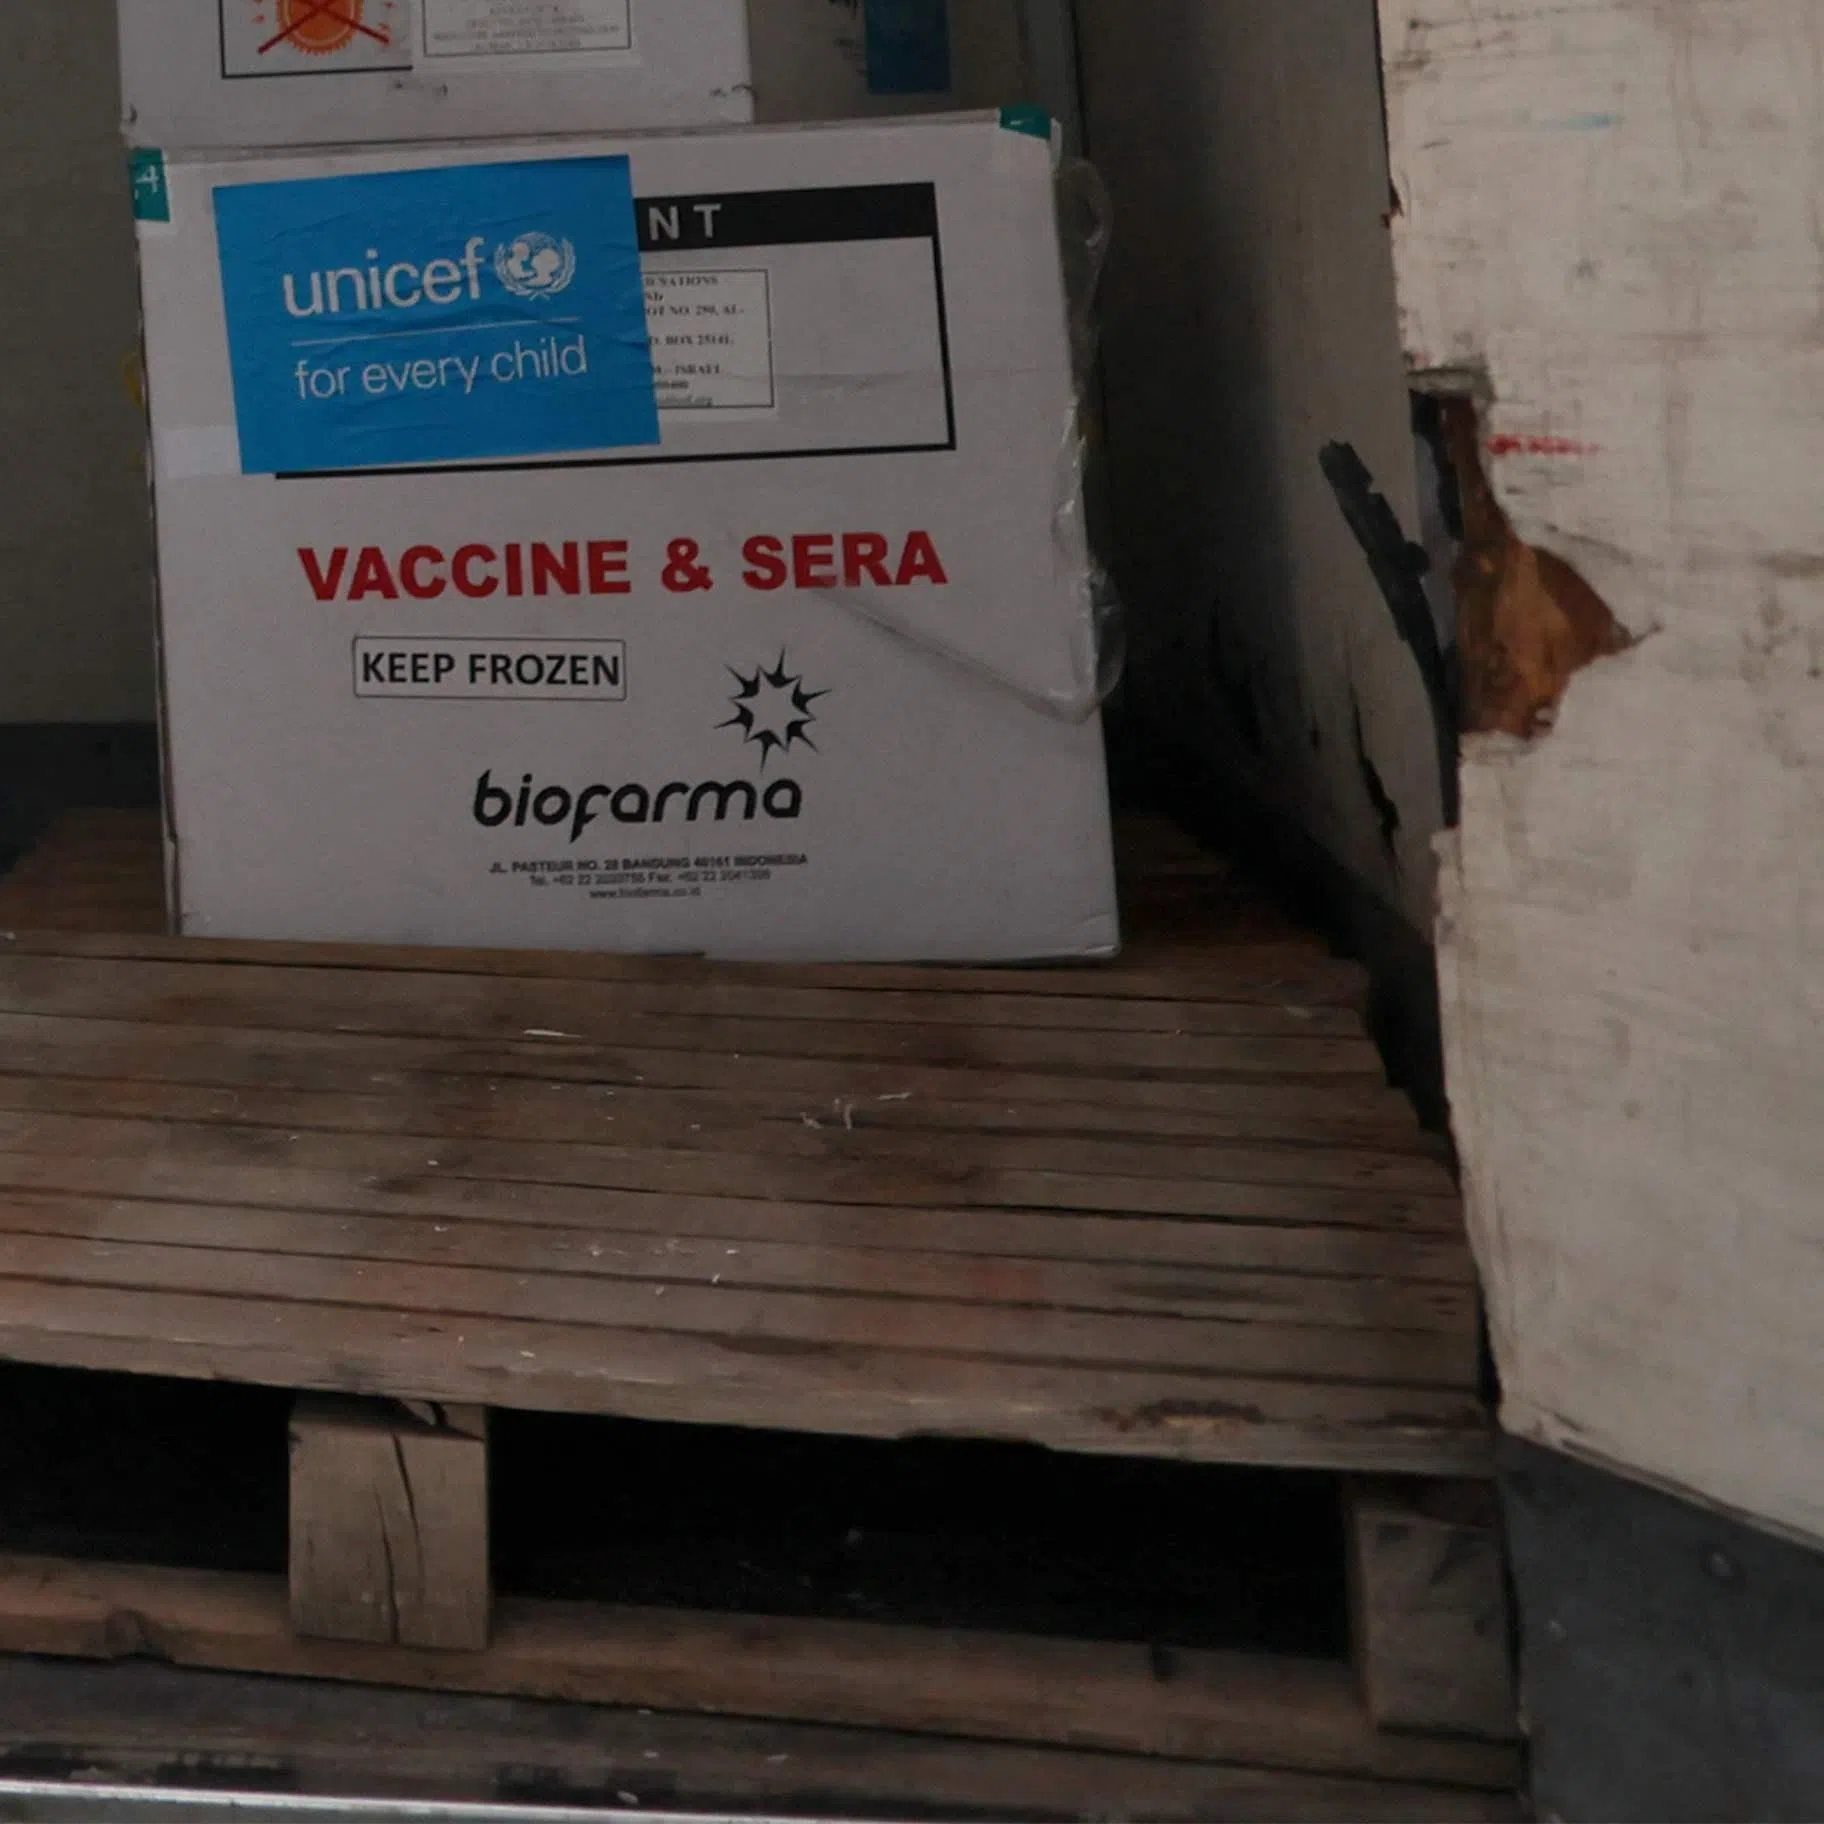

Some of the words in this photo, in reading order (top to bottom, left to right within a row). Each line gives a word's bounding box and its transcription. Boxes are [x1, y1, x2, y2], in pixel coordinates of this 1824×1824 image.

[283, 238, 484, 318] unicef
[294, 359, 349, 402] for
[360, 351, 480, 399] every
[490, 335, 587, 383] child
[297, 541, 631, 602] VACCINE
[661, 538, 713, 592] &
[742, 531, 947, 590] SERA
[360, 651, 457, 685] KEEP
[468, 653, 621, 688] FROZEN
[474, 770, 801, 842] biofarma
[512, 859, 573, 872] PASTEUR
